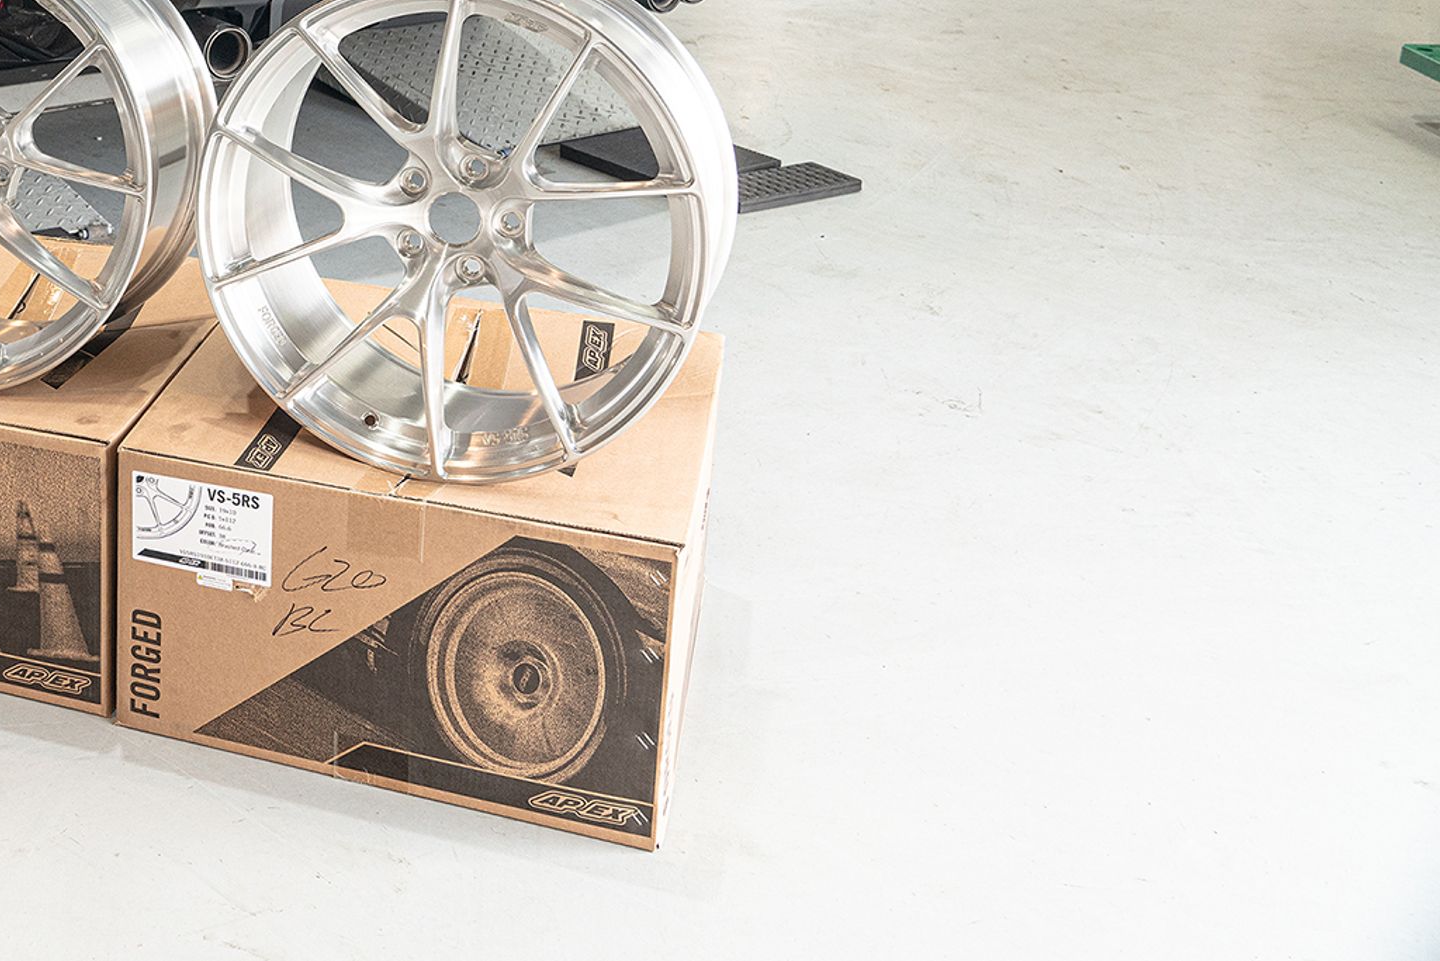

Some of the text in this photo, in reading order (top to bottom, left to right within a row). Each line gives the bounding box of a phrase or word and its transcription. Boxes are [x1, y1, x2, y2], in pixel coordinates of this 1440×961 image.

[583, 324, 608, 372] APEX
[207, 488, 260, 510] VS-5RS
[271, 603, 341, 637] BC
[3, 663, 91, 694] APEX
[130, 609, 162, 719] FORGED
[528, 790, 639, 825] APEX
